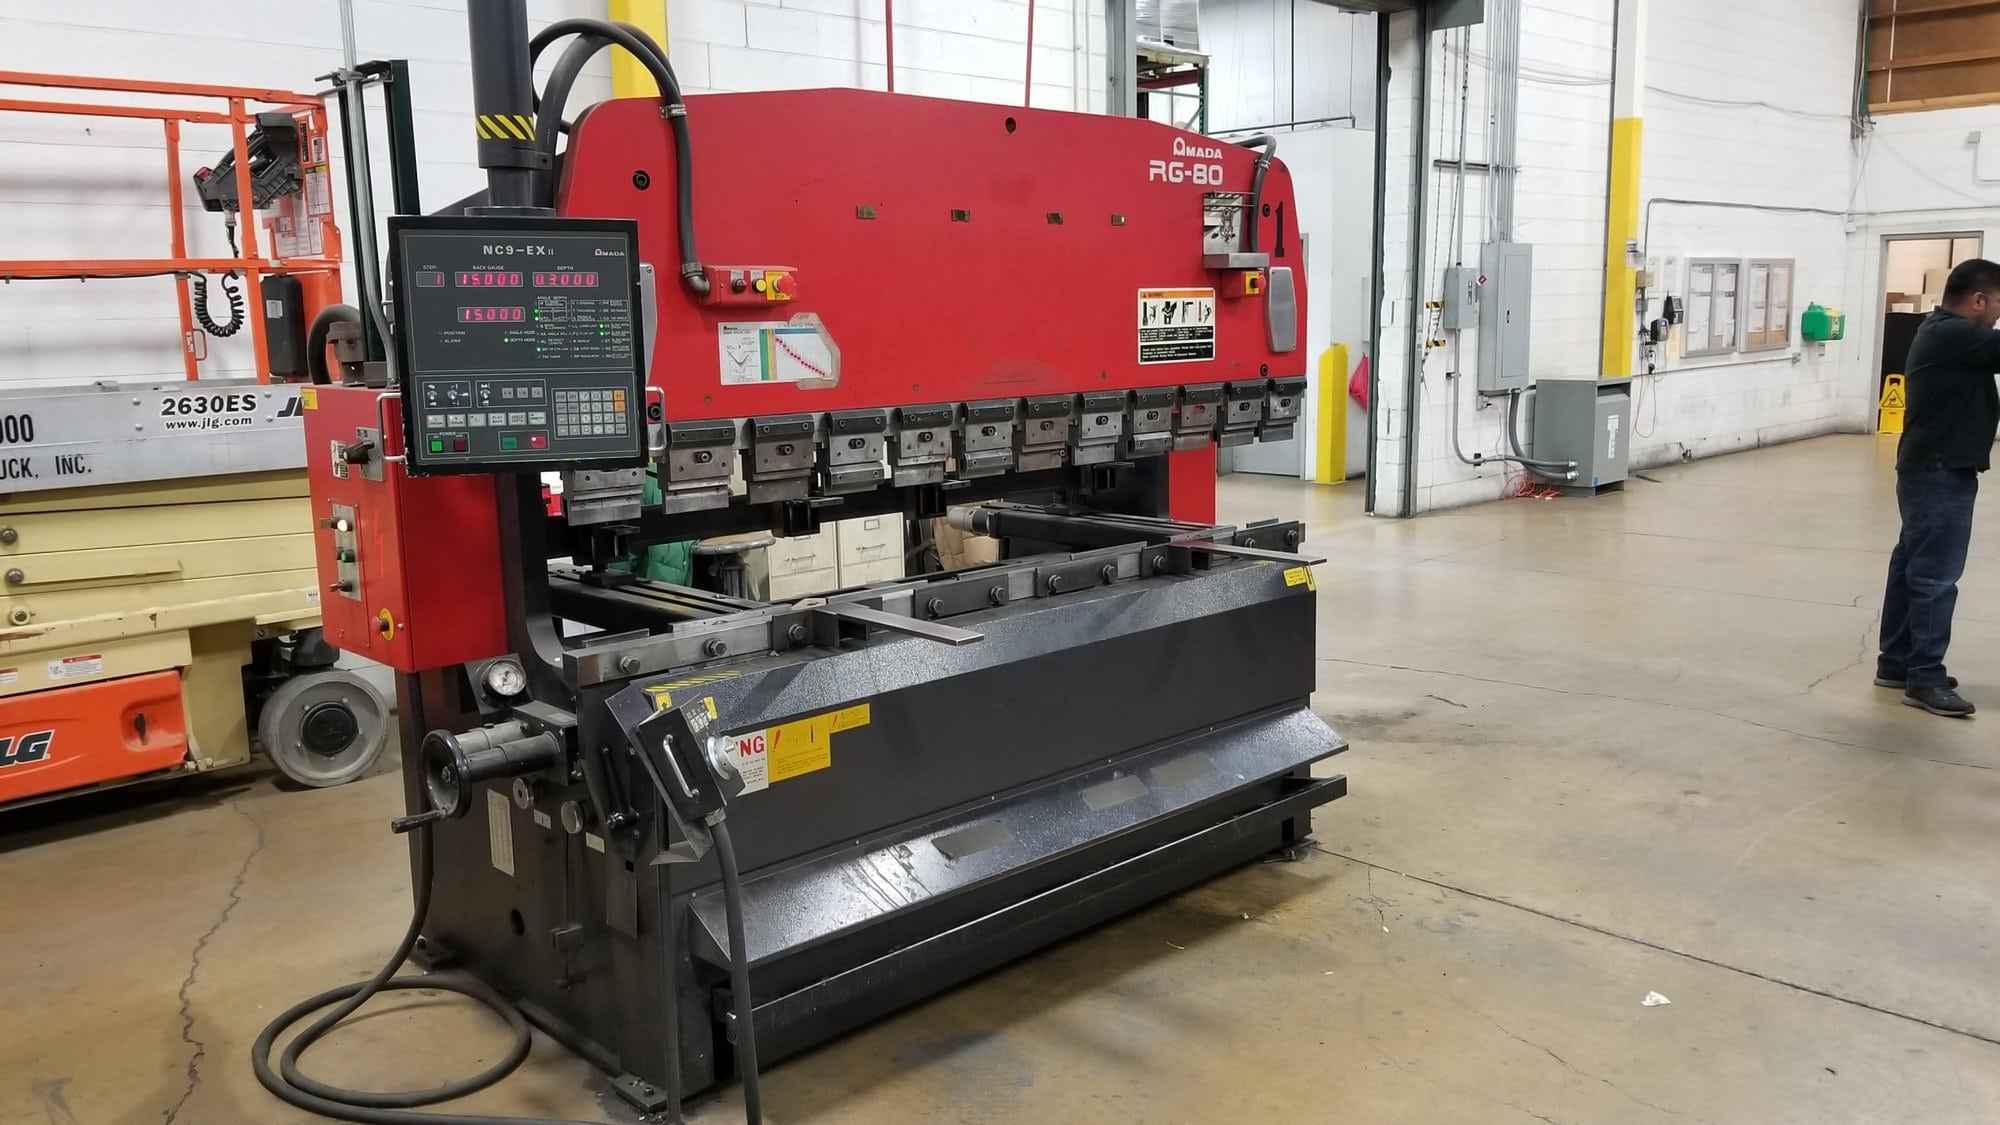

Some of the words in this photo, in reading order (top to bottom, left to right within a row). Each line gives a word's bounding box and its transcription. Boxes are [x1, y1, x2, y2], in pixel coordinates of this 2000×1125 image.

[1149, 160, 1223, 185] RG-80
[161, 394, 257, 416] 2630ES
[0, 414, 34, 444] 00
[166, 417, 252, 430] www.jlg.com
[55, 453, 92, 475] INC.
